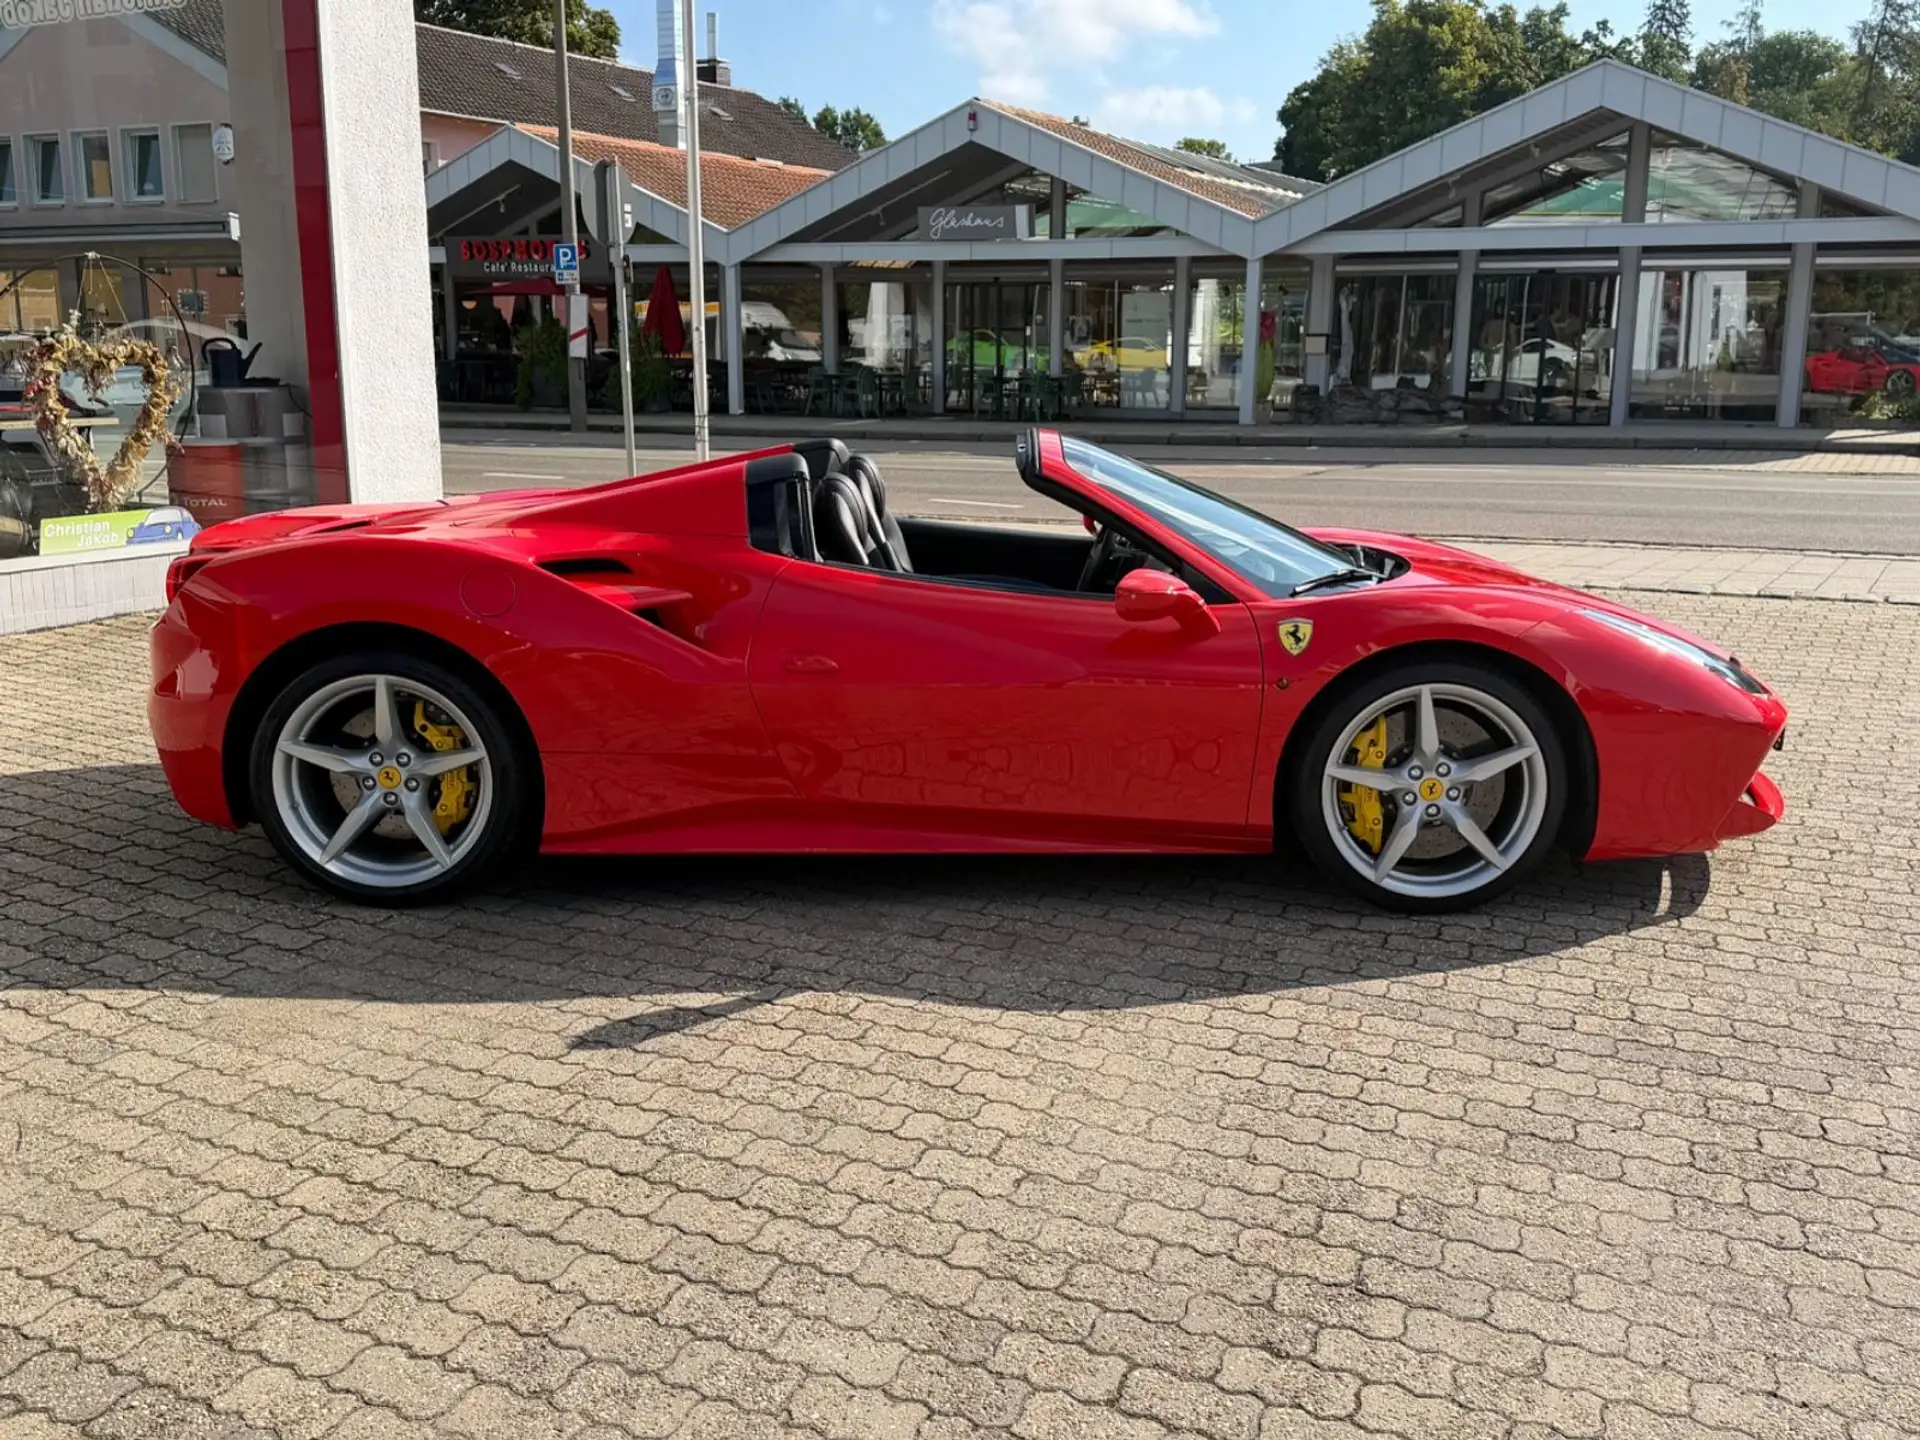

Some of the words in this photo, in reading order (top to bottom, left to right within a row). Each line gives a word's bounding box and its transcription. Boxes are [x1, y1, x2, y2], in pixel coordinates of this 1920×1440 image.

[559, 247, 572, 269] P
[511, 262, 556, 273] Restaura
[183, 496, 228, 508] TOTAL
[44, 520, 111, 538] Christian
[77, 533, 119, 547] Jakob
